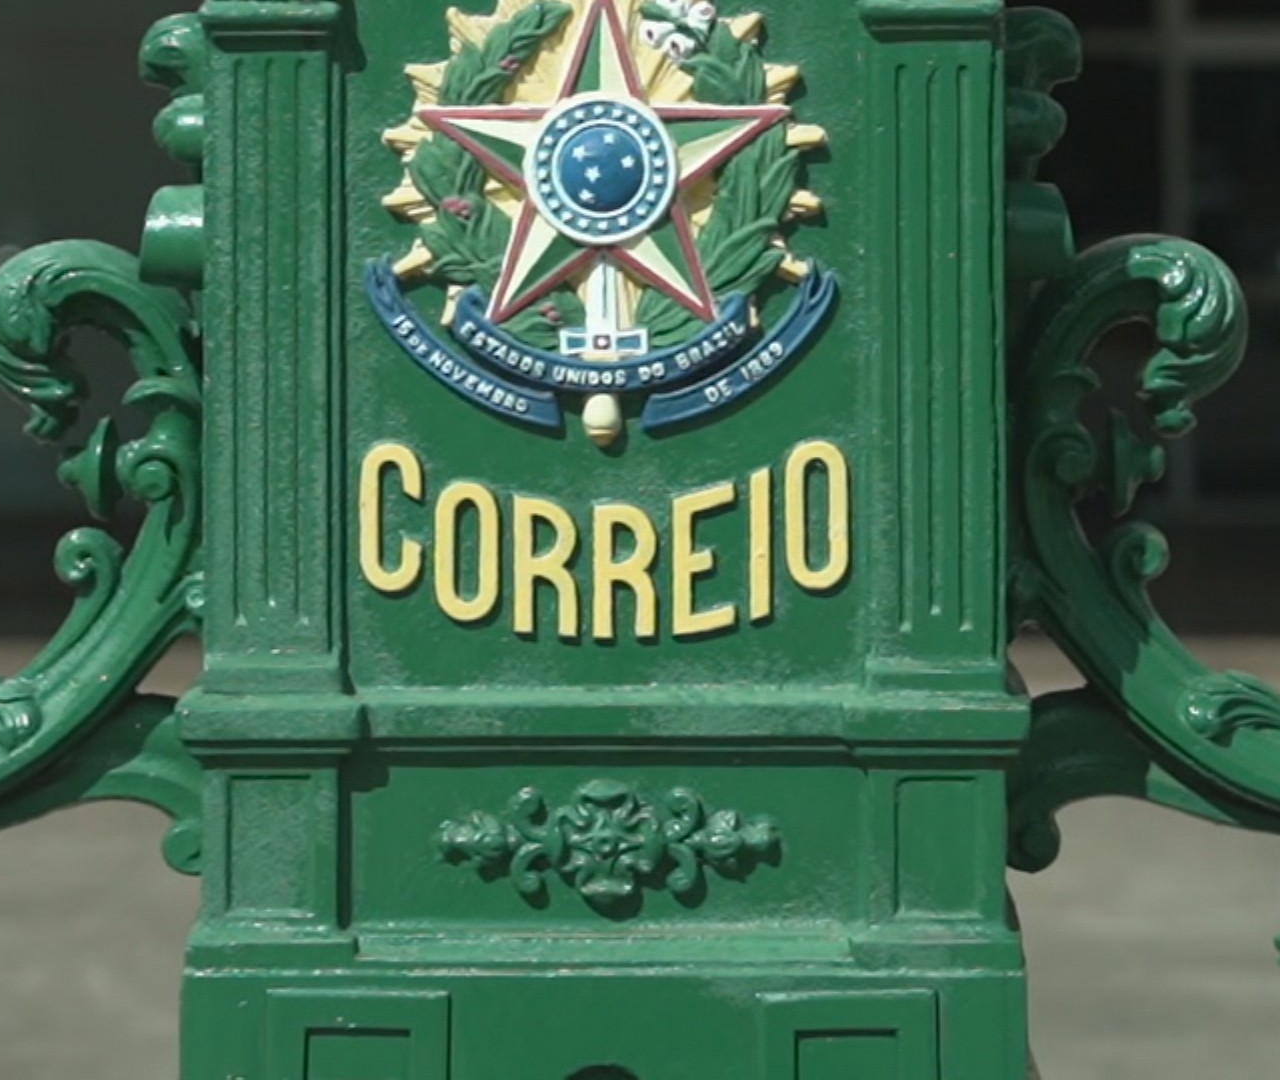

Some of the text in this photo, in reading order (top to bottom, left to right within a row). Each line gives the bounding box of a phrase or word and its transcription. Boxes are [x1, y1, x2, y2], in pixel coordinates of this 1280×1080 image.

[392, 314, 415, 336] 15
[428, 349, 528, 413] NOVEMBRO
[704, 378, 733, 403] DE
[740, 341, 784, 381] 1889
[459, 320, 746, 386] ESTADOS UNIDOS DO BRAZIL
[359, 441, 850, 639] CORREIO
